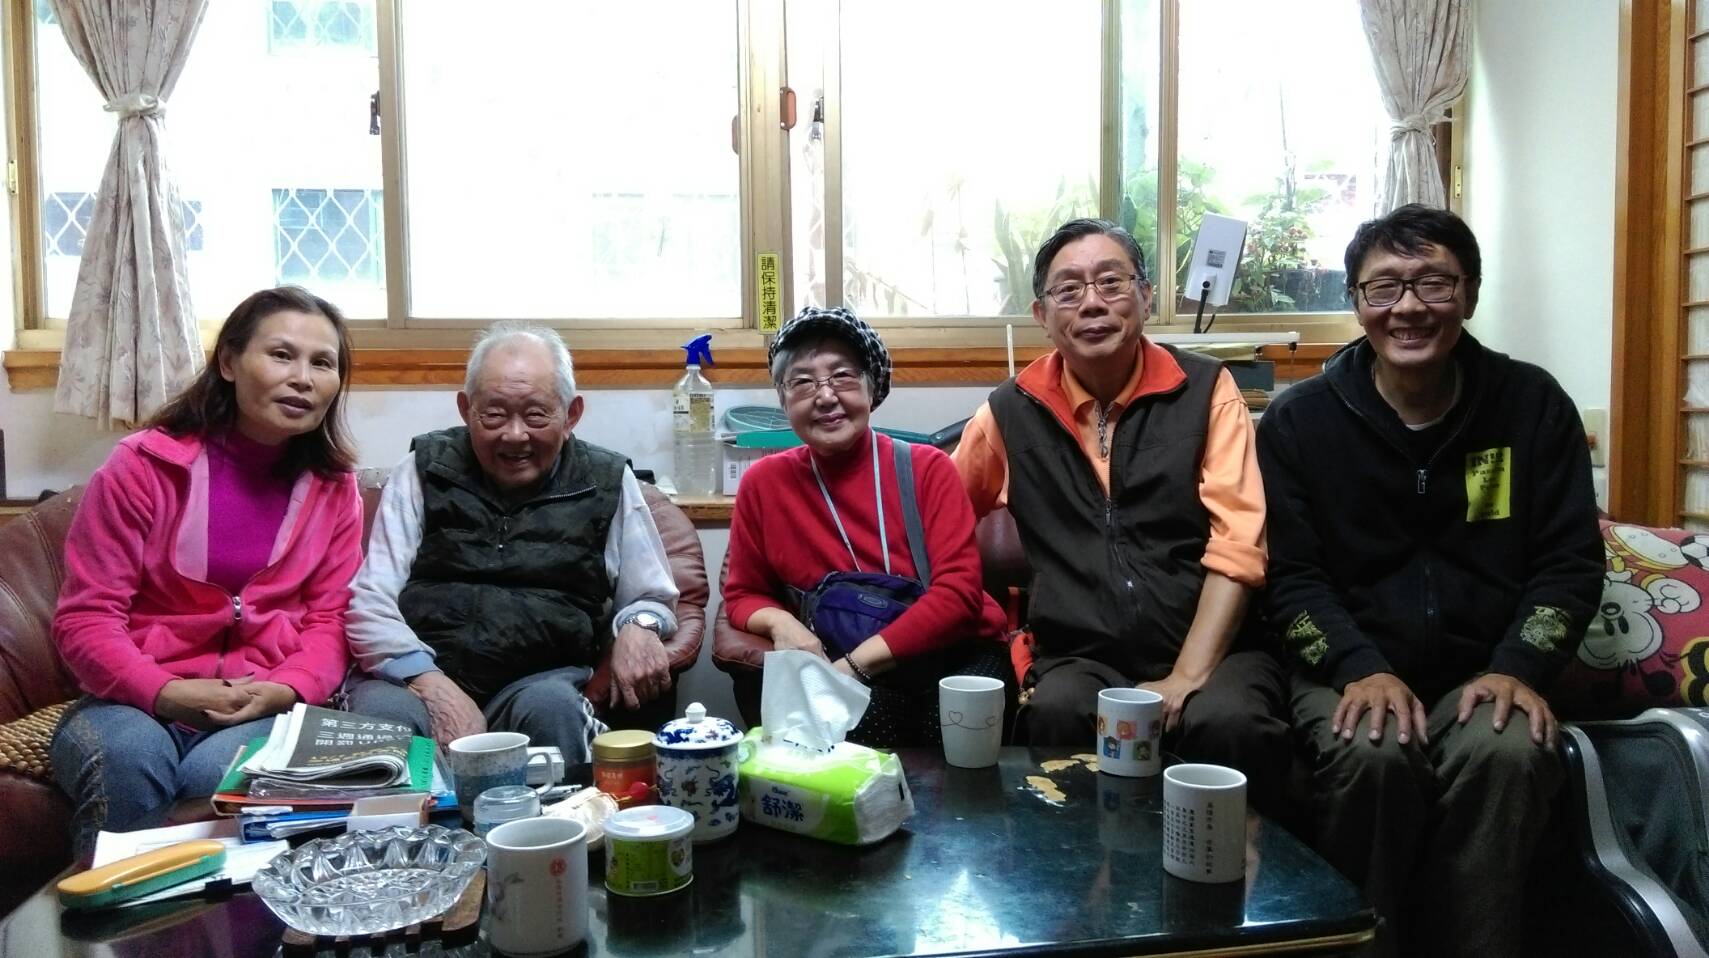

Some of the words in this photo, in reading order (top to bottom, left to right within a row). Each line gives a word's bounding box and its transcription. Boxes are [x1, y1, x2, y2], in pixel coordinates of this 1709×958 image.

[761, 256, 777, 330] 請保持清潔
[761, 793, 804, 821] 舒潔
